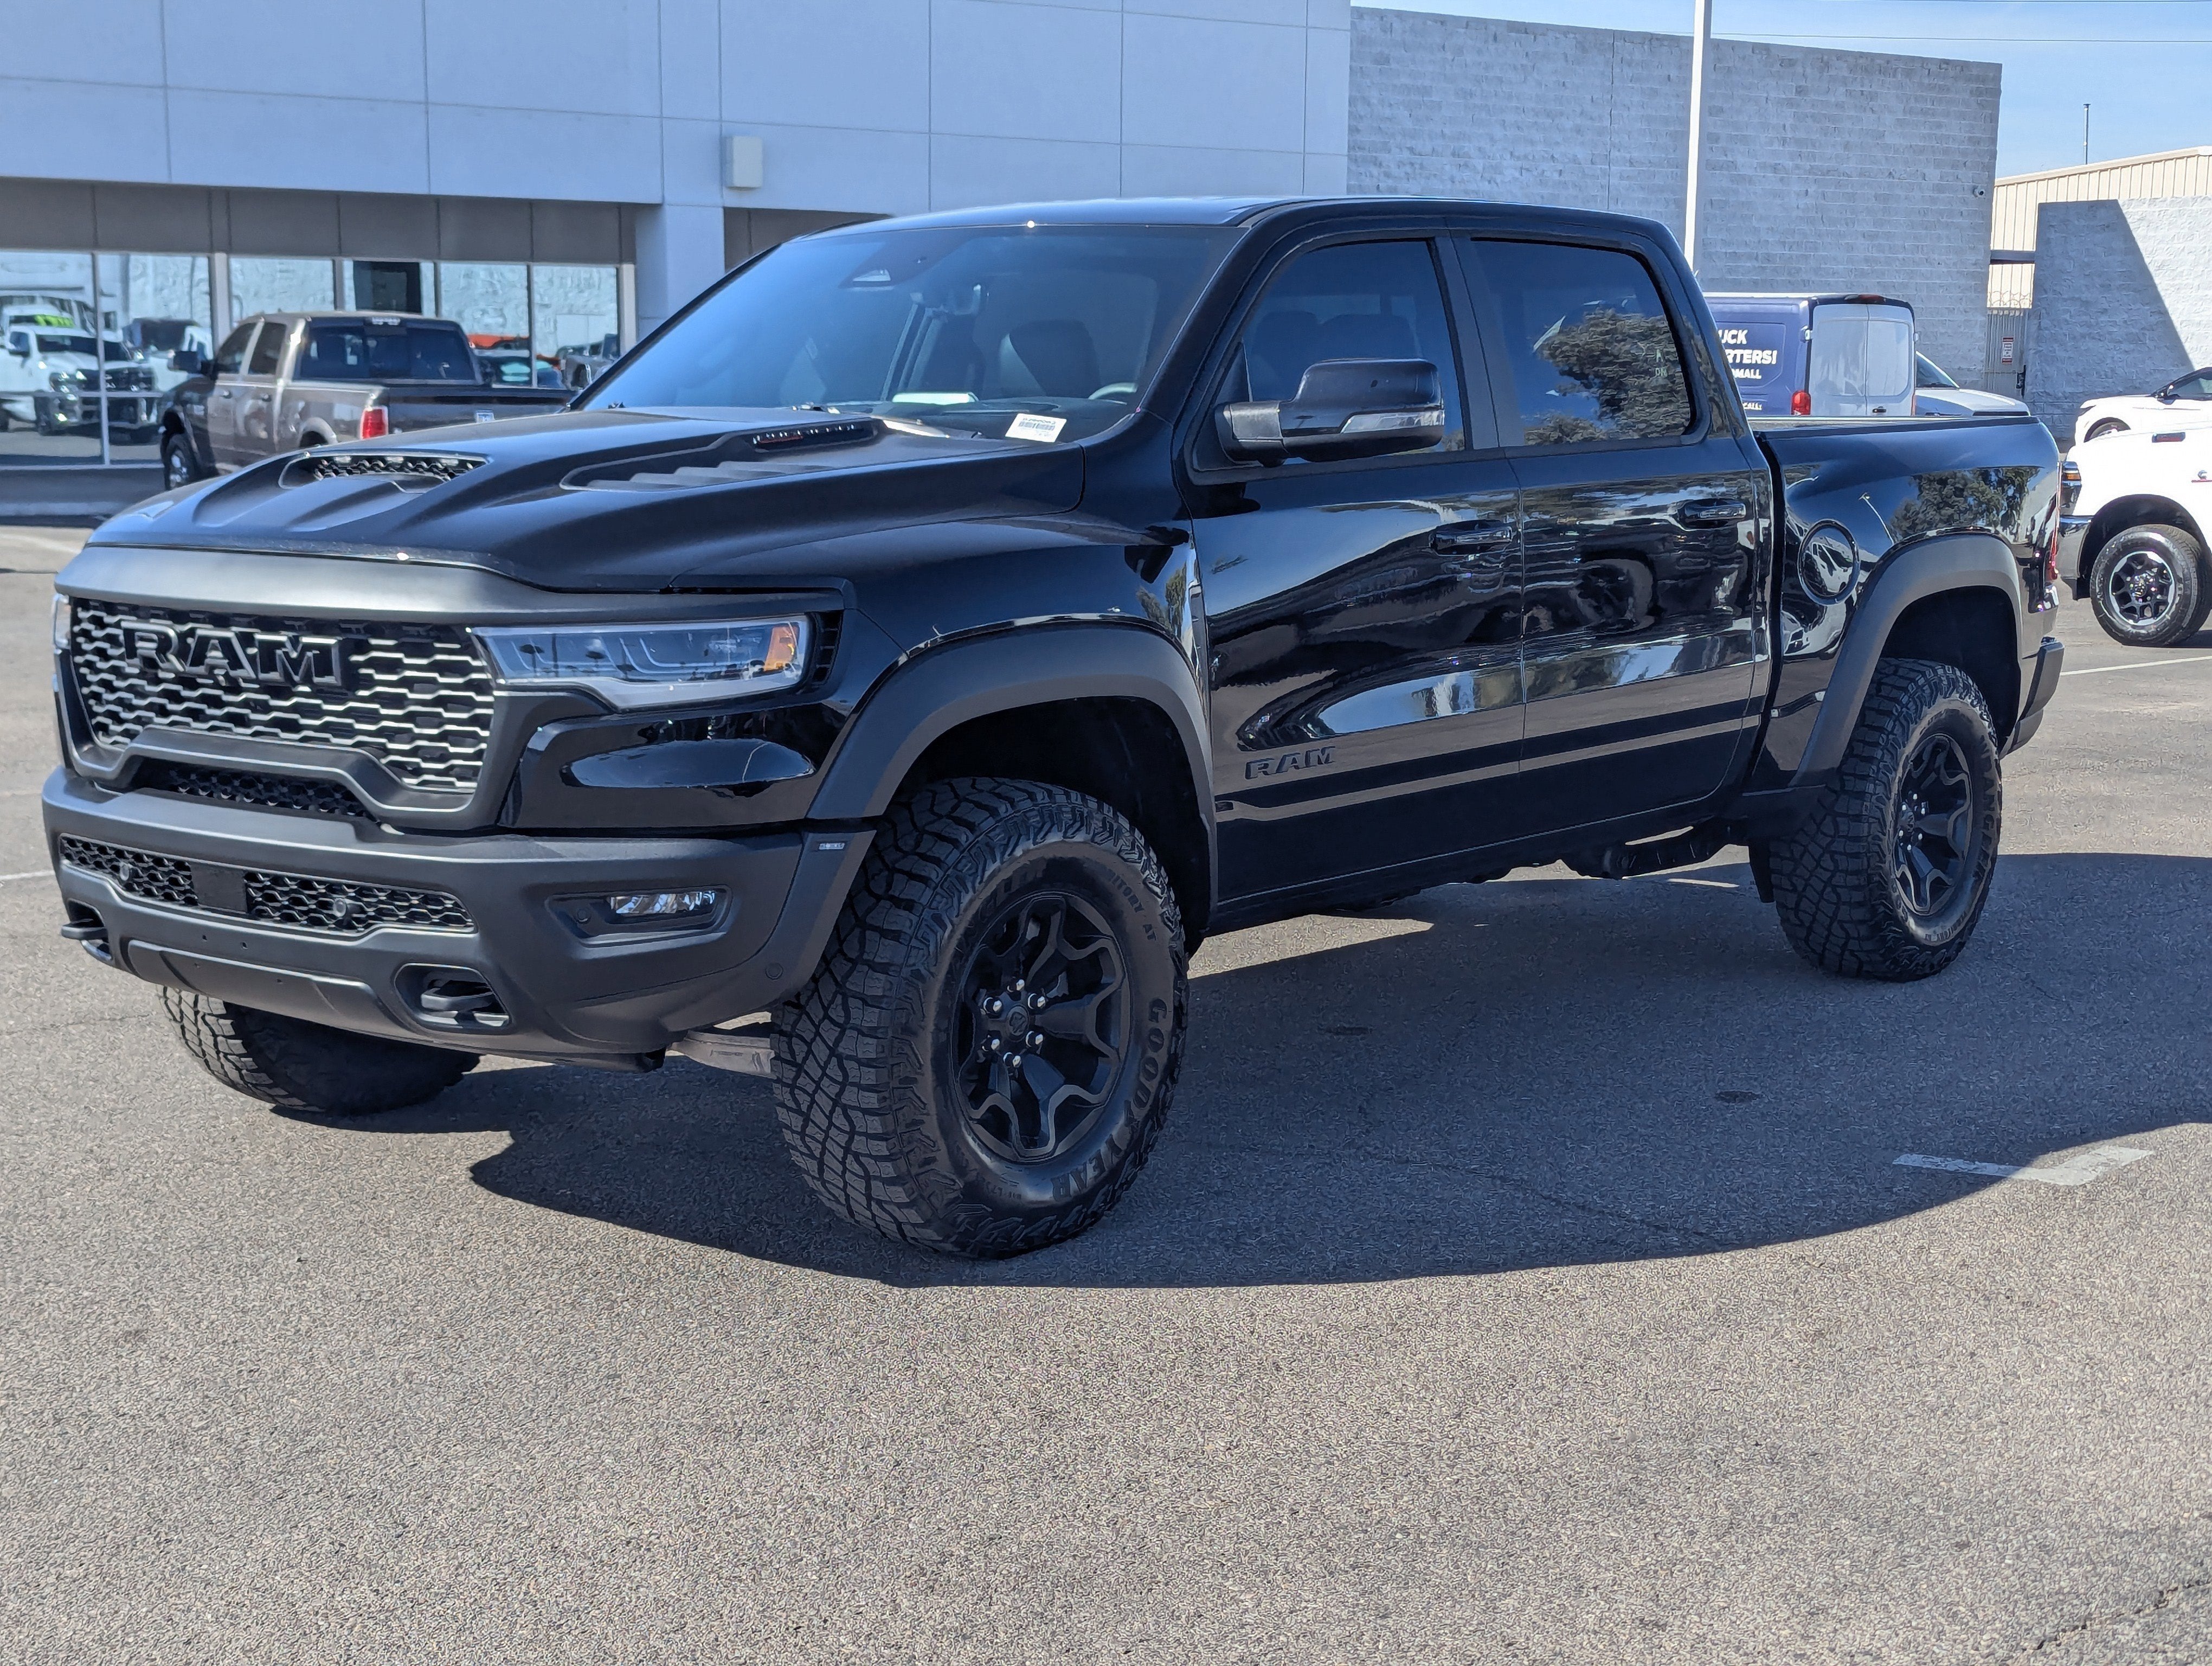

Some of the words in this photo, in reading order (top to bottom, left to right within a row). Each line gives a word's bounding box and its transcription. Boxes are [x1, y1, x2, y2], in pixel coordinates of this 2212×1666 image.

[120, 620, 344, 686] RAM
[1244, 746, 1336, 780] RAM
[1143, 924, 1156, 940] AT
[1052, 998, 1168, 1202] GOODYEAR
